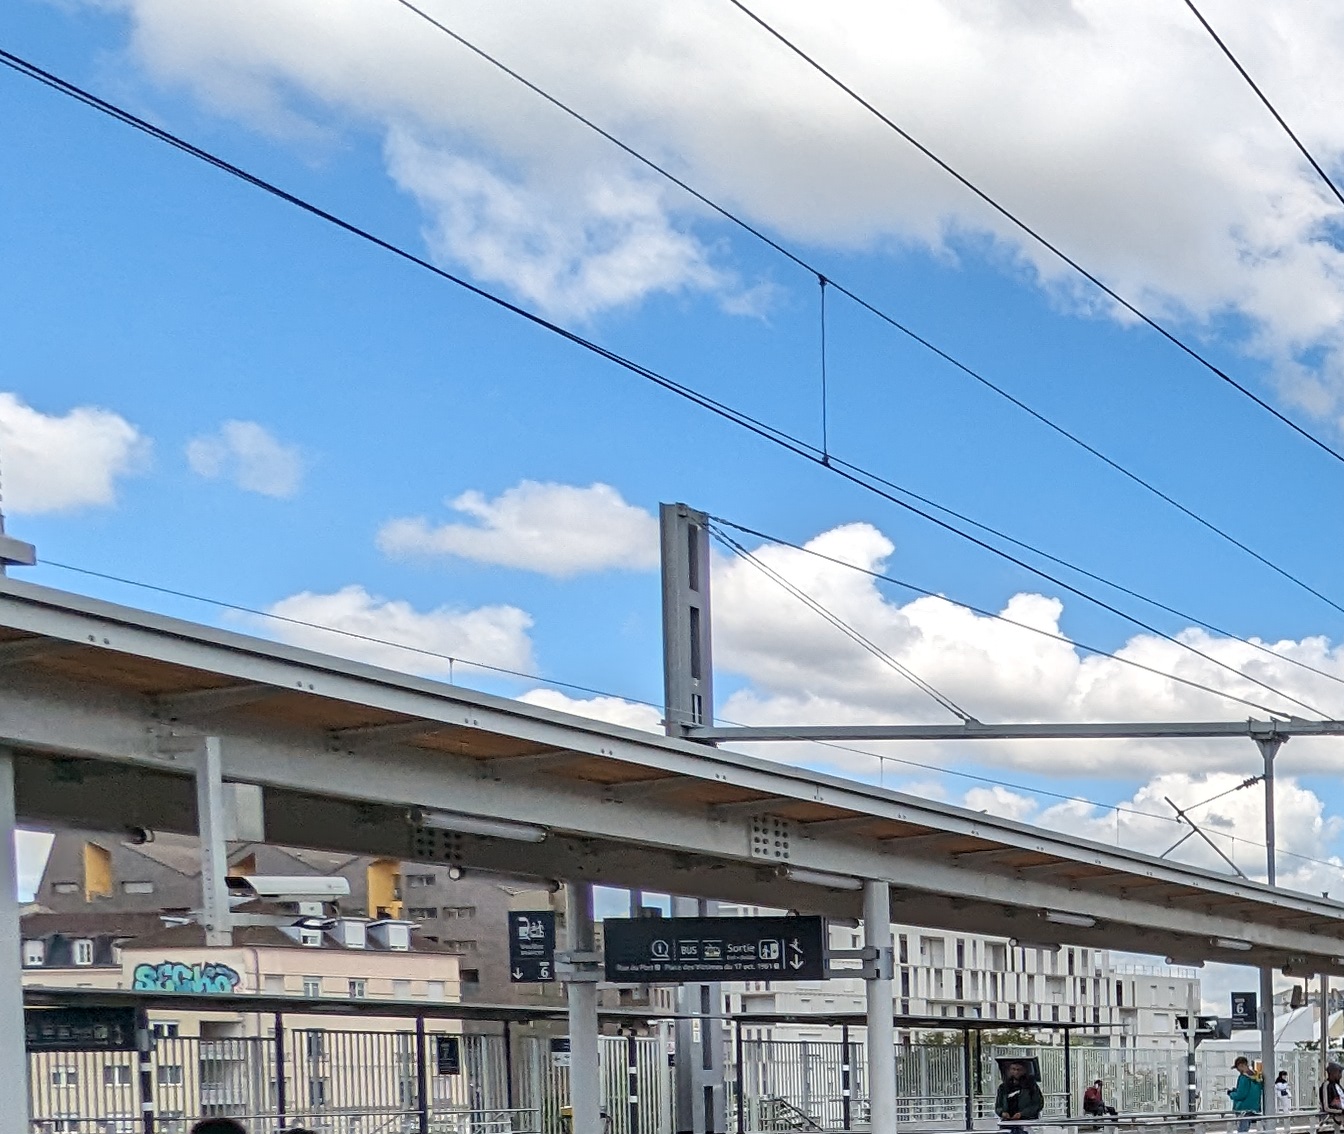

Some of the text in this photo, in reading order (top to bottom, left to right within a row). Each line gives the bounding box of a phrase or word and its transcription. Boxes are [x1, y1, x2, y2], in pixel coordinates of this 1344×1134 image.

[680, 943, 755, 955] BUS Sortie
[540, 966, 549, 978] 6
[1236, 1002, 1245, 1014] 6
